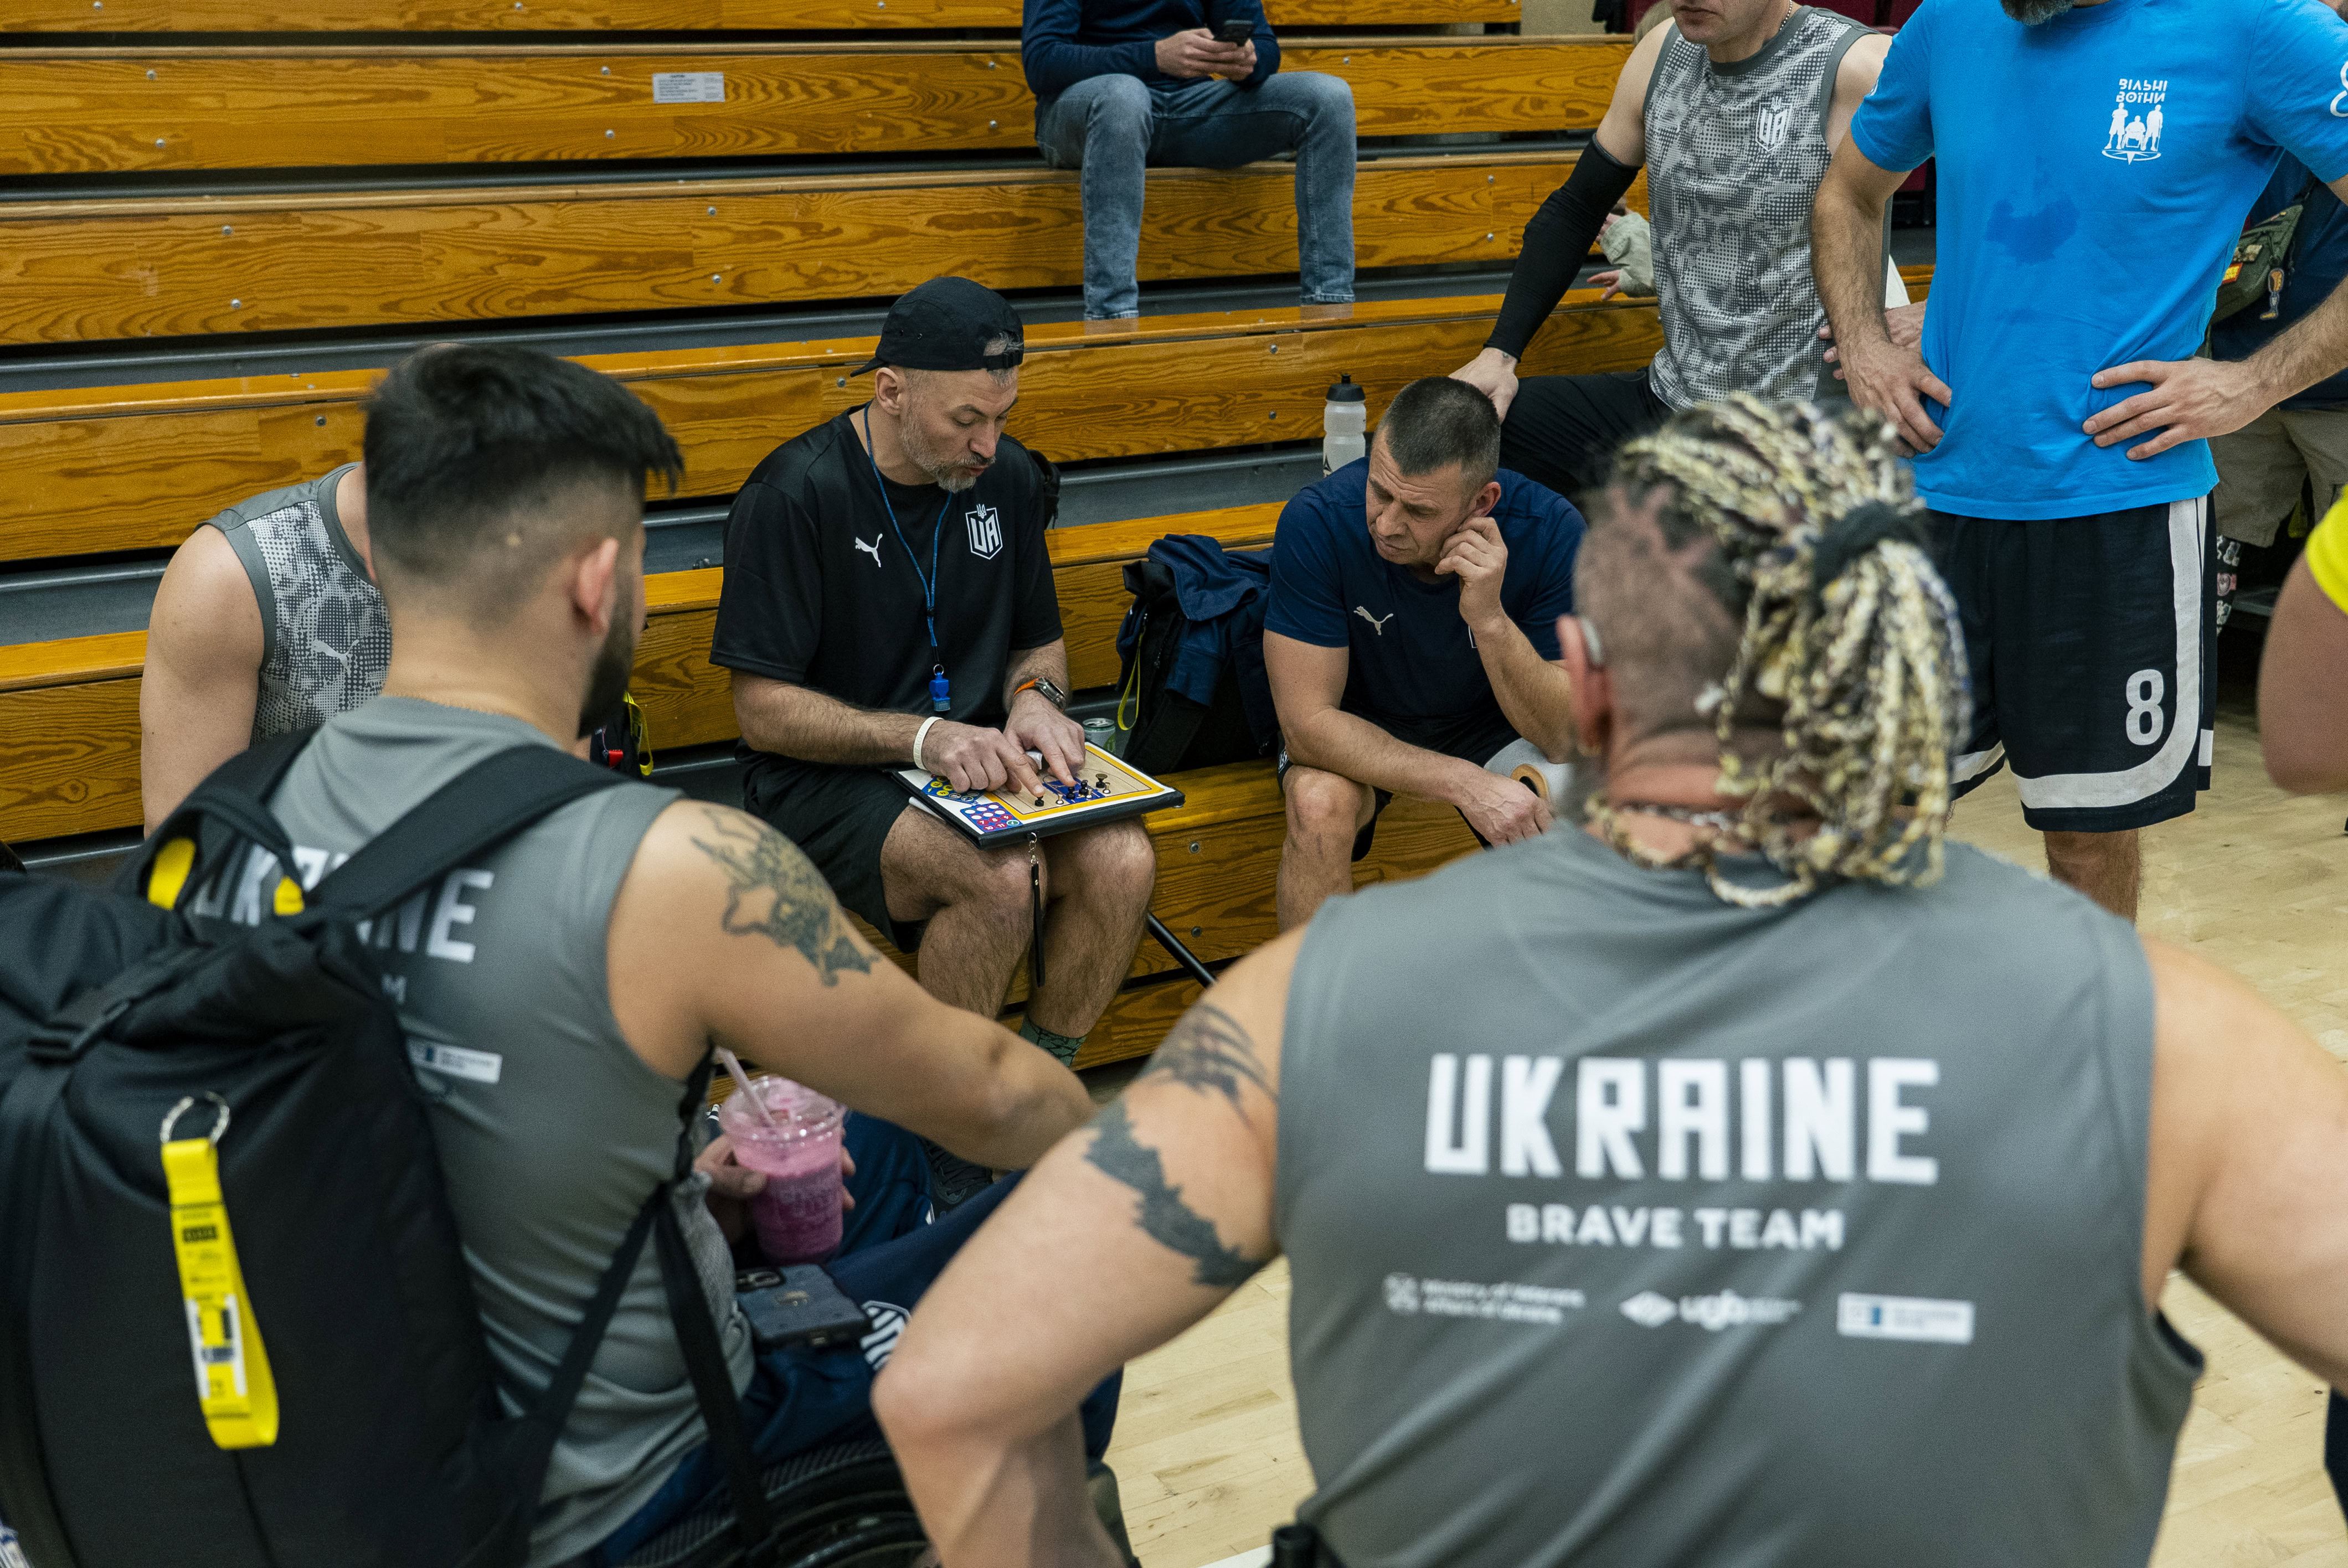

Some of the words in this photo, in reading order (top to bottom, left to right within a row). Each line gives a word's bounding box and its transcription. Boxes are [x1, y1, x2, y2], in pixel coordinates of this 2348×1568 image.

[2116, 91, 2165, 104] ВОЇНИ
[2119, 78, 2168, 91] ВІЛЬНІ
[1758, 107, 1788, 146] UA
[970, 514, 1000, 553] UA
[2126, 669, 2164, 745] 8
[1424, 1054, 1939, 1185] UKRAINE
[1506, 1203, 1684, 1249] BRAVE
[1693, 1207, 1844, 1251] TEAM
